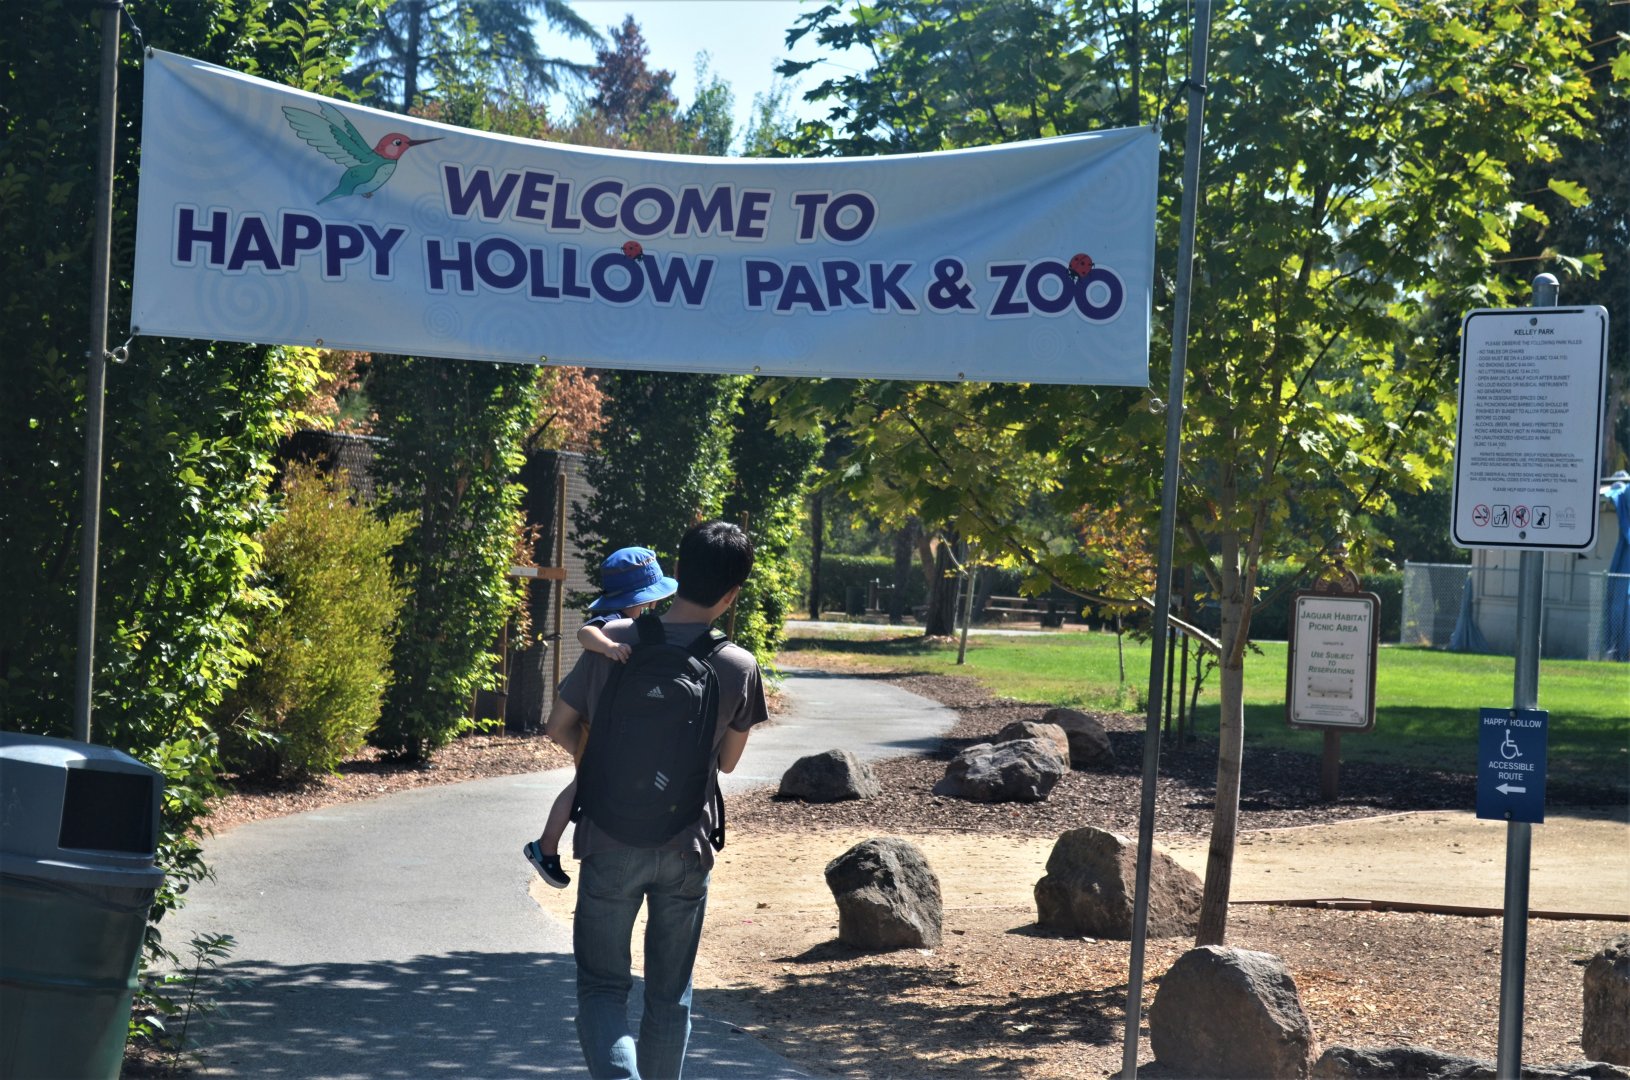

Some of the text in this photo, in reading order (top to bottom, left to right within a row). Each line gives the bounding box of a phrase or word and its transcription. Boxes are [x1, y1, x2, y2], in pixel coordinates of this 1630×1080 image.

[444, 165, 876, 242] WELCOME TO
[177, 208, 1123, 321] HAPPY HOLLOW PARK & ZOO
[1301, 611, 1368, 622] JAGUAR HABITAT
[1308, 622, 1358, 632] PICNIC AREA
[1326, 652, 1354, 660] SUBJECT
[1308, 666, 1355, 675] RESERVATIONS
[1484, 718, 1542, 728] HAPPY HOLLOW
[1488, 761, 1534, 771] ACCESSIBLE
[1498, 772, 1524, 780] ROUTE
